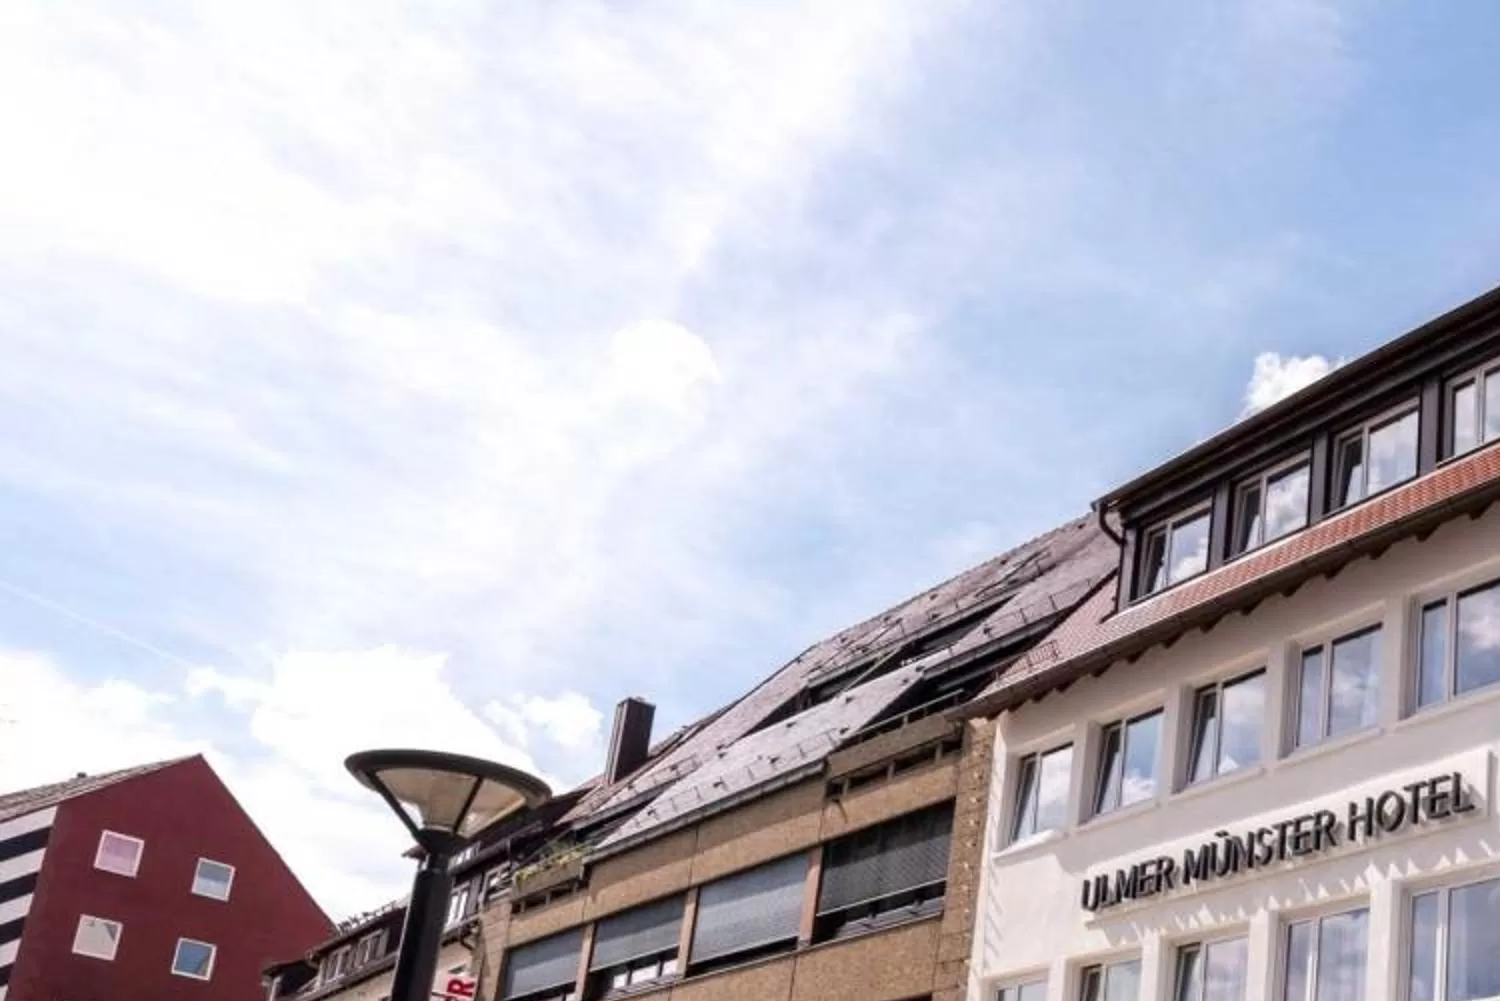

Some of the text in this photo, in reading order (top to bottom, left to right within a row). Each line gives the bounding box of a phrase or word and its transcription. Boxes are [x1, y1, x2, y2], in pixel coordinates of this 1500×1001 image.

[1080, 771, 1477, 912] ULMER MÜNSTER HOTEL
